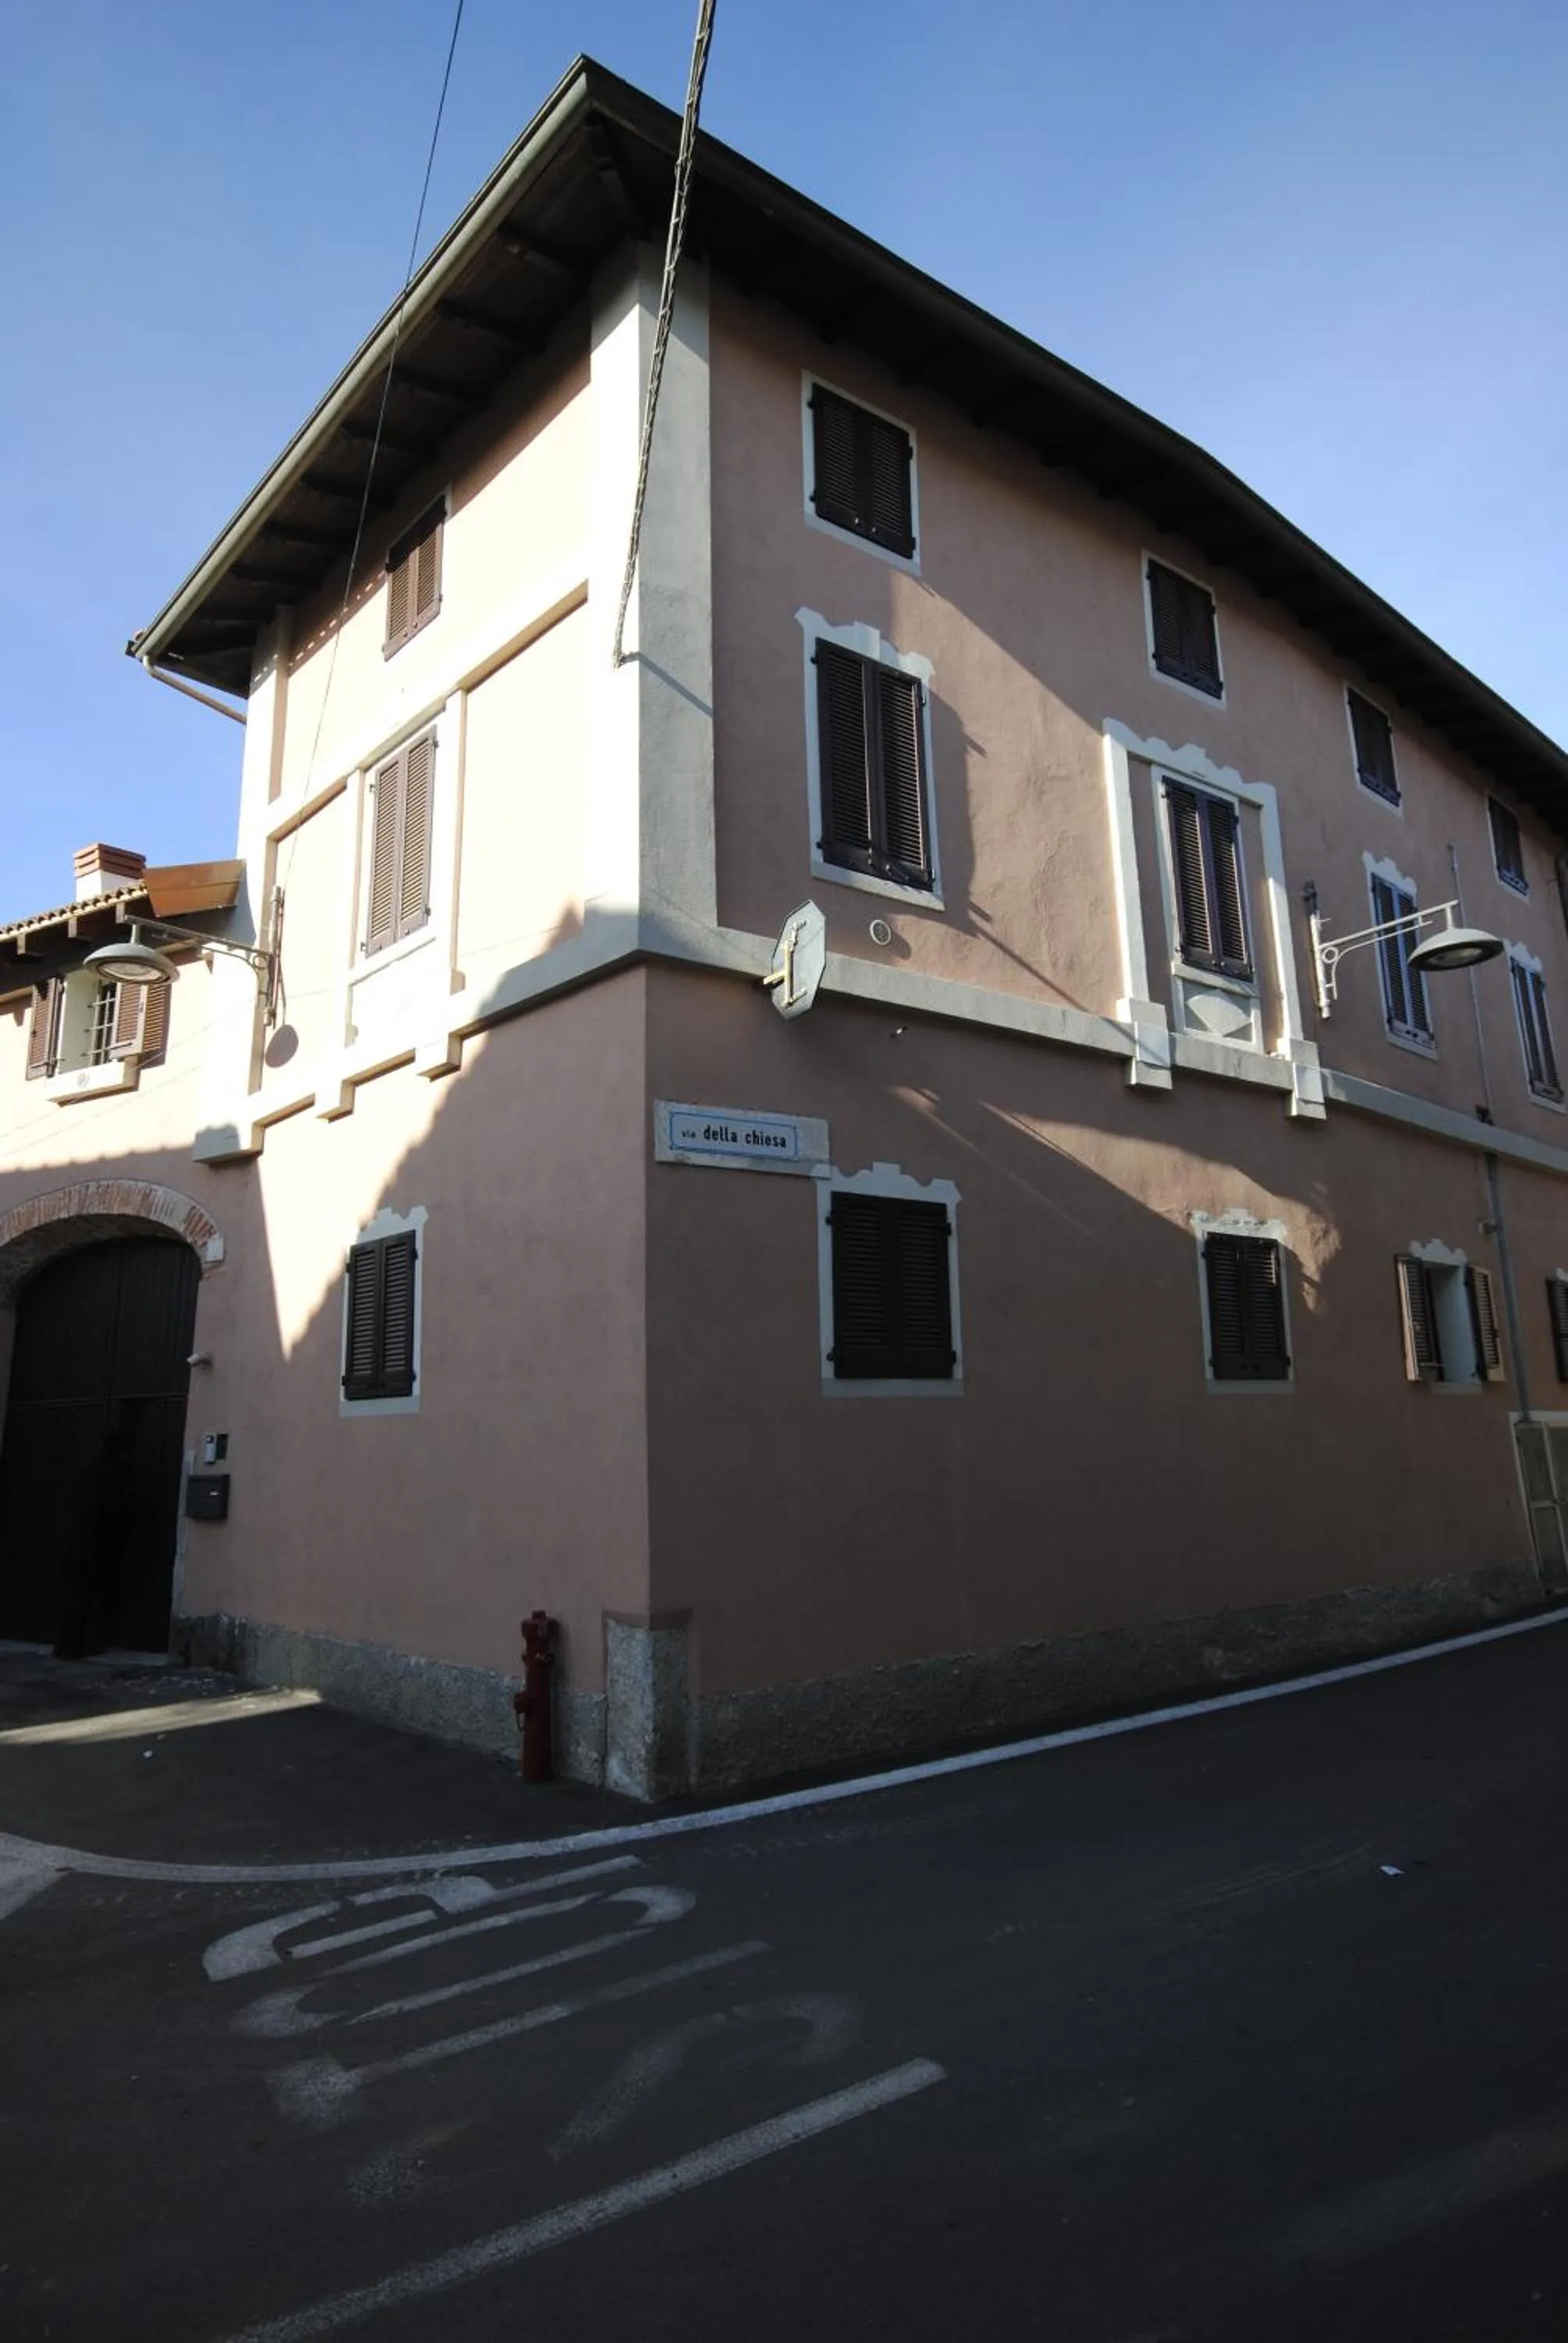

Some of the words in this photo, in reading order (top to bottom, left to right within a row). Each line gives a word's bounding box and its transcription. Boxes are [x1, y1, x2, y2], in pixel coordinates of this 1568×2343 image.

[681, 1129, 696, 1139] via
[704, 1125, 737, 1143] della
[745, 1129, 786, 1147] chiesa
